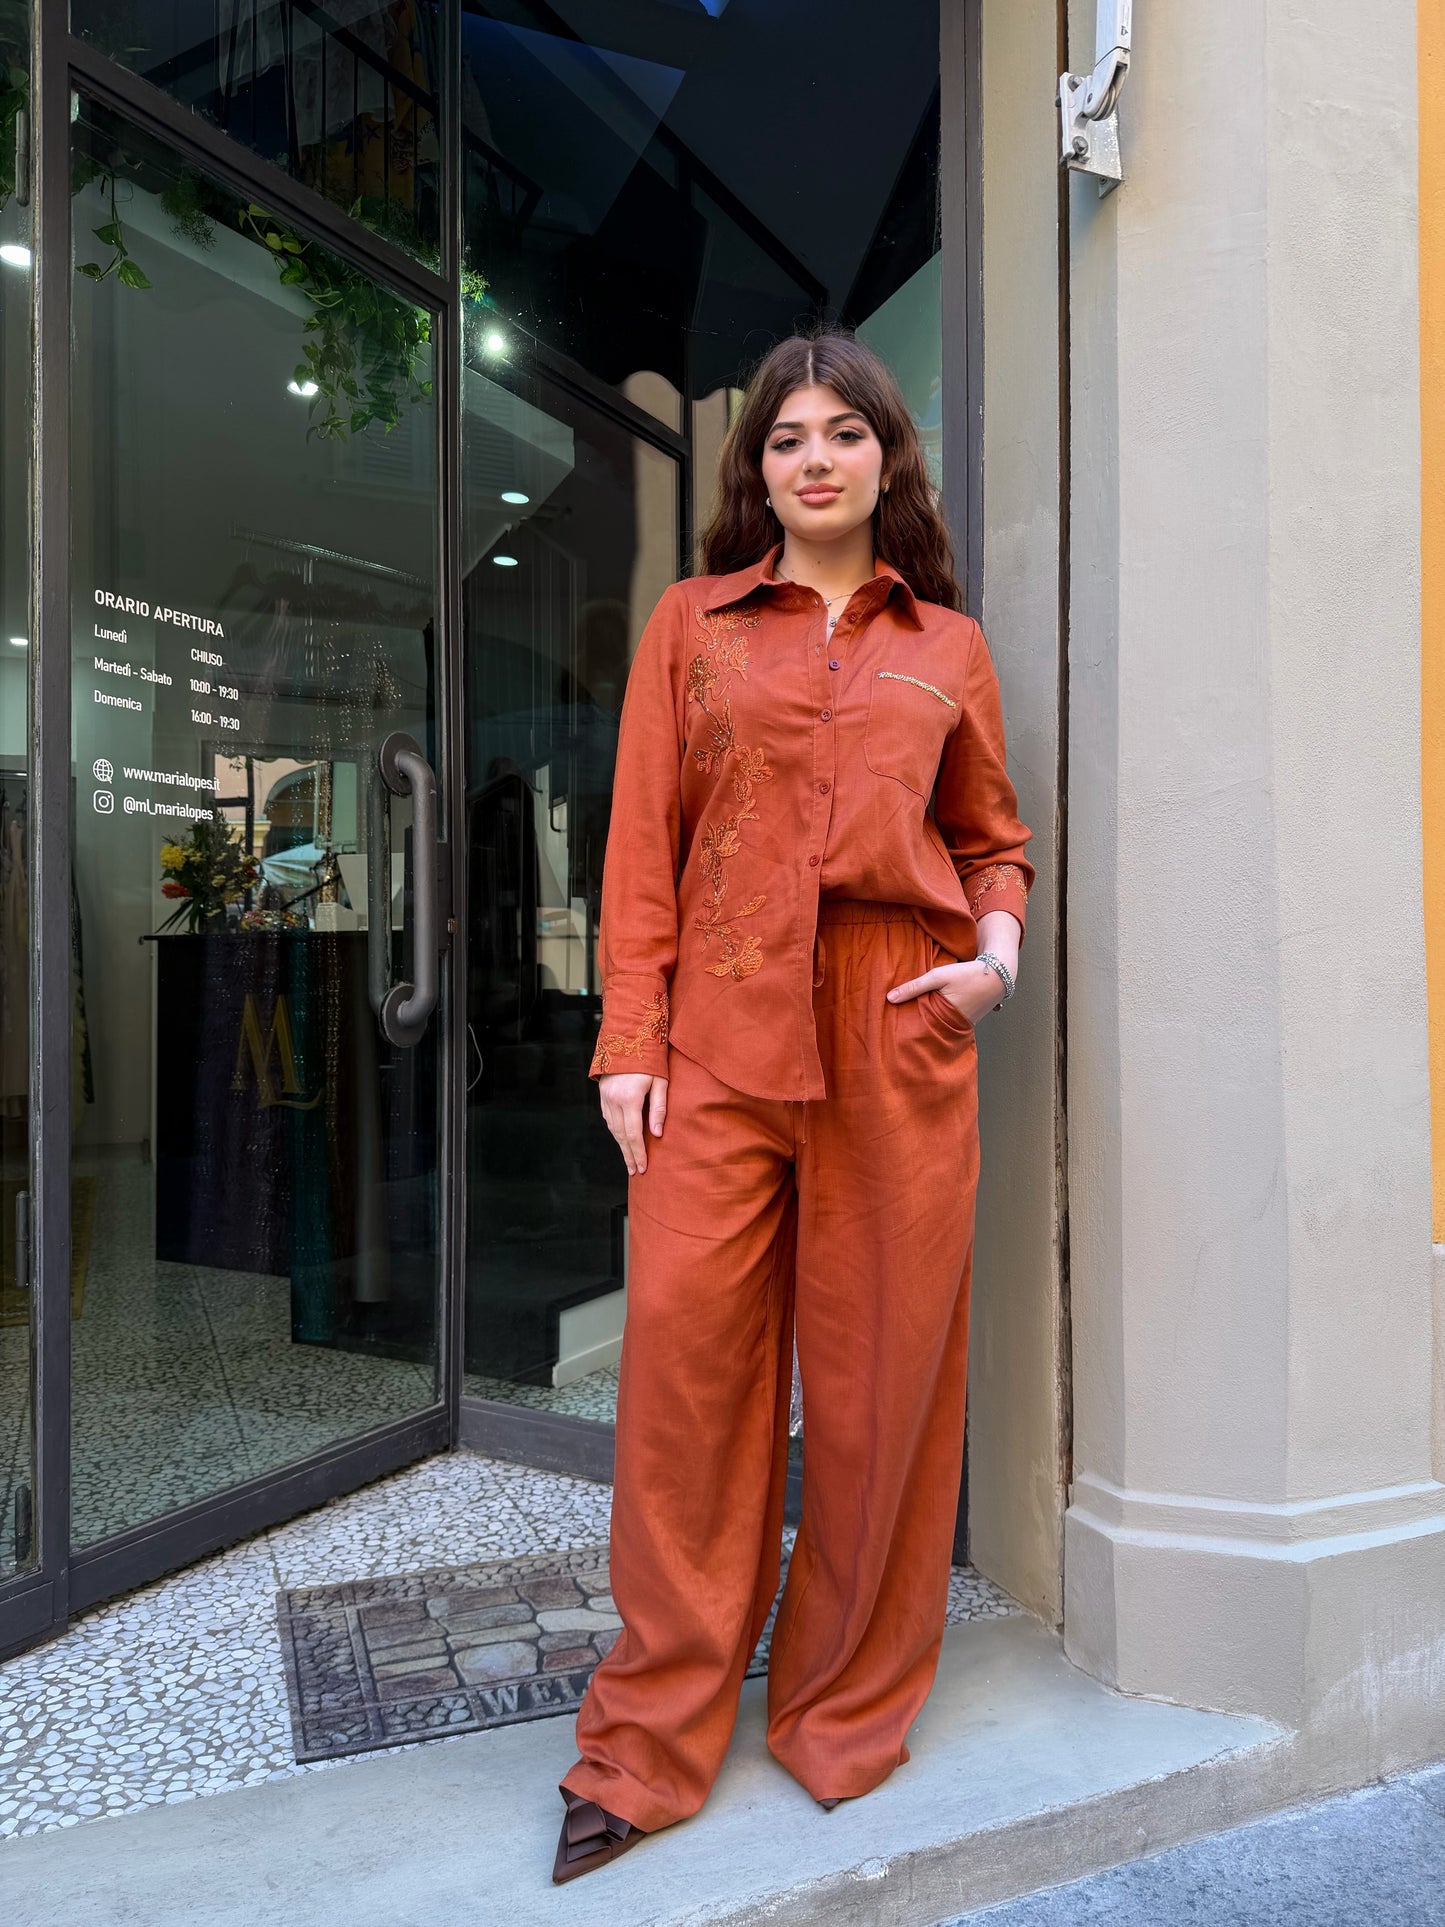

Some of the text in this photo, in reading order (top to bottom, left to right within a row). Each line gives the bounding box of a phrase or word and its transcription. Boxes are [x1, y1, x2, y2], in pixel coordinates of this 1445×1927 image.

[94, 589, 225, 638] ORARIO APERTURA
[94, 623, 128, 644] Lunedì
[190, 648, 223, 667] CHIUSO
[94, 656, 132, 677] Martedì
[140, 667, 173, 686] Sabato
[94, 689, 143, 712] Domenica
[189, 678, 211, 694] 10:00
[218, 685, 239, 701] 19:30
[190, 709, 212, 725] 16:00
[219, 715, 240, 731] 19:30
[123, 766, 220, 792] www.marialopes.it
[123, 796, 214, 823] @ml_marialopes
